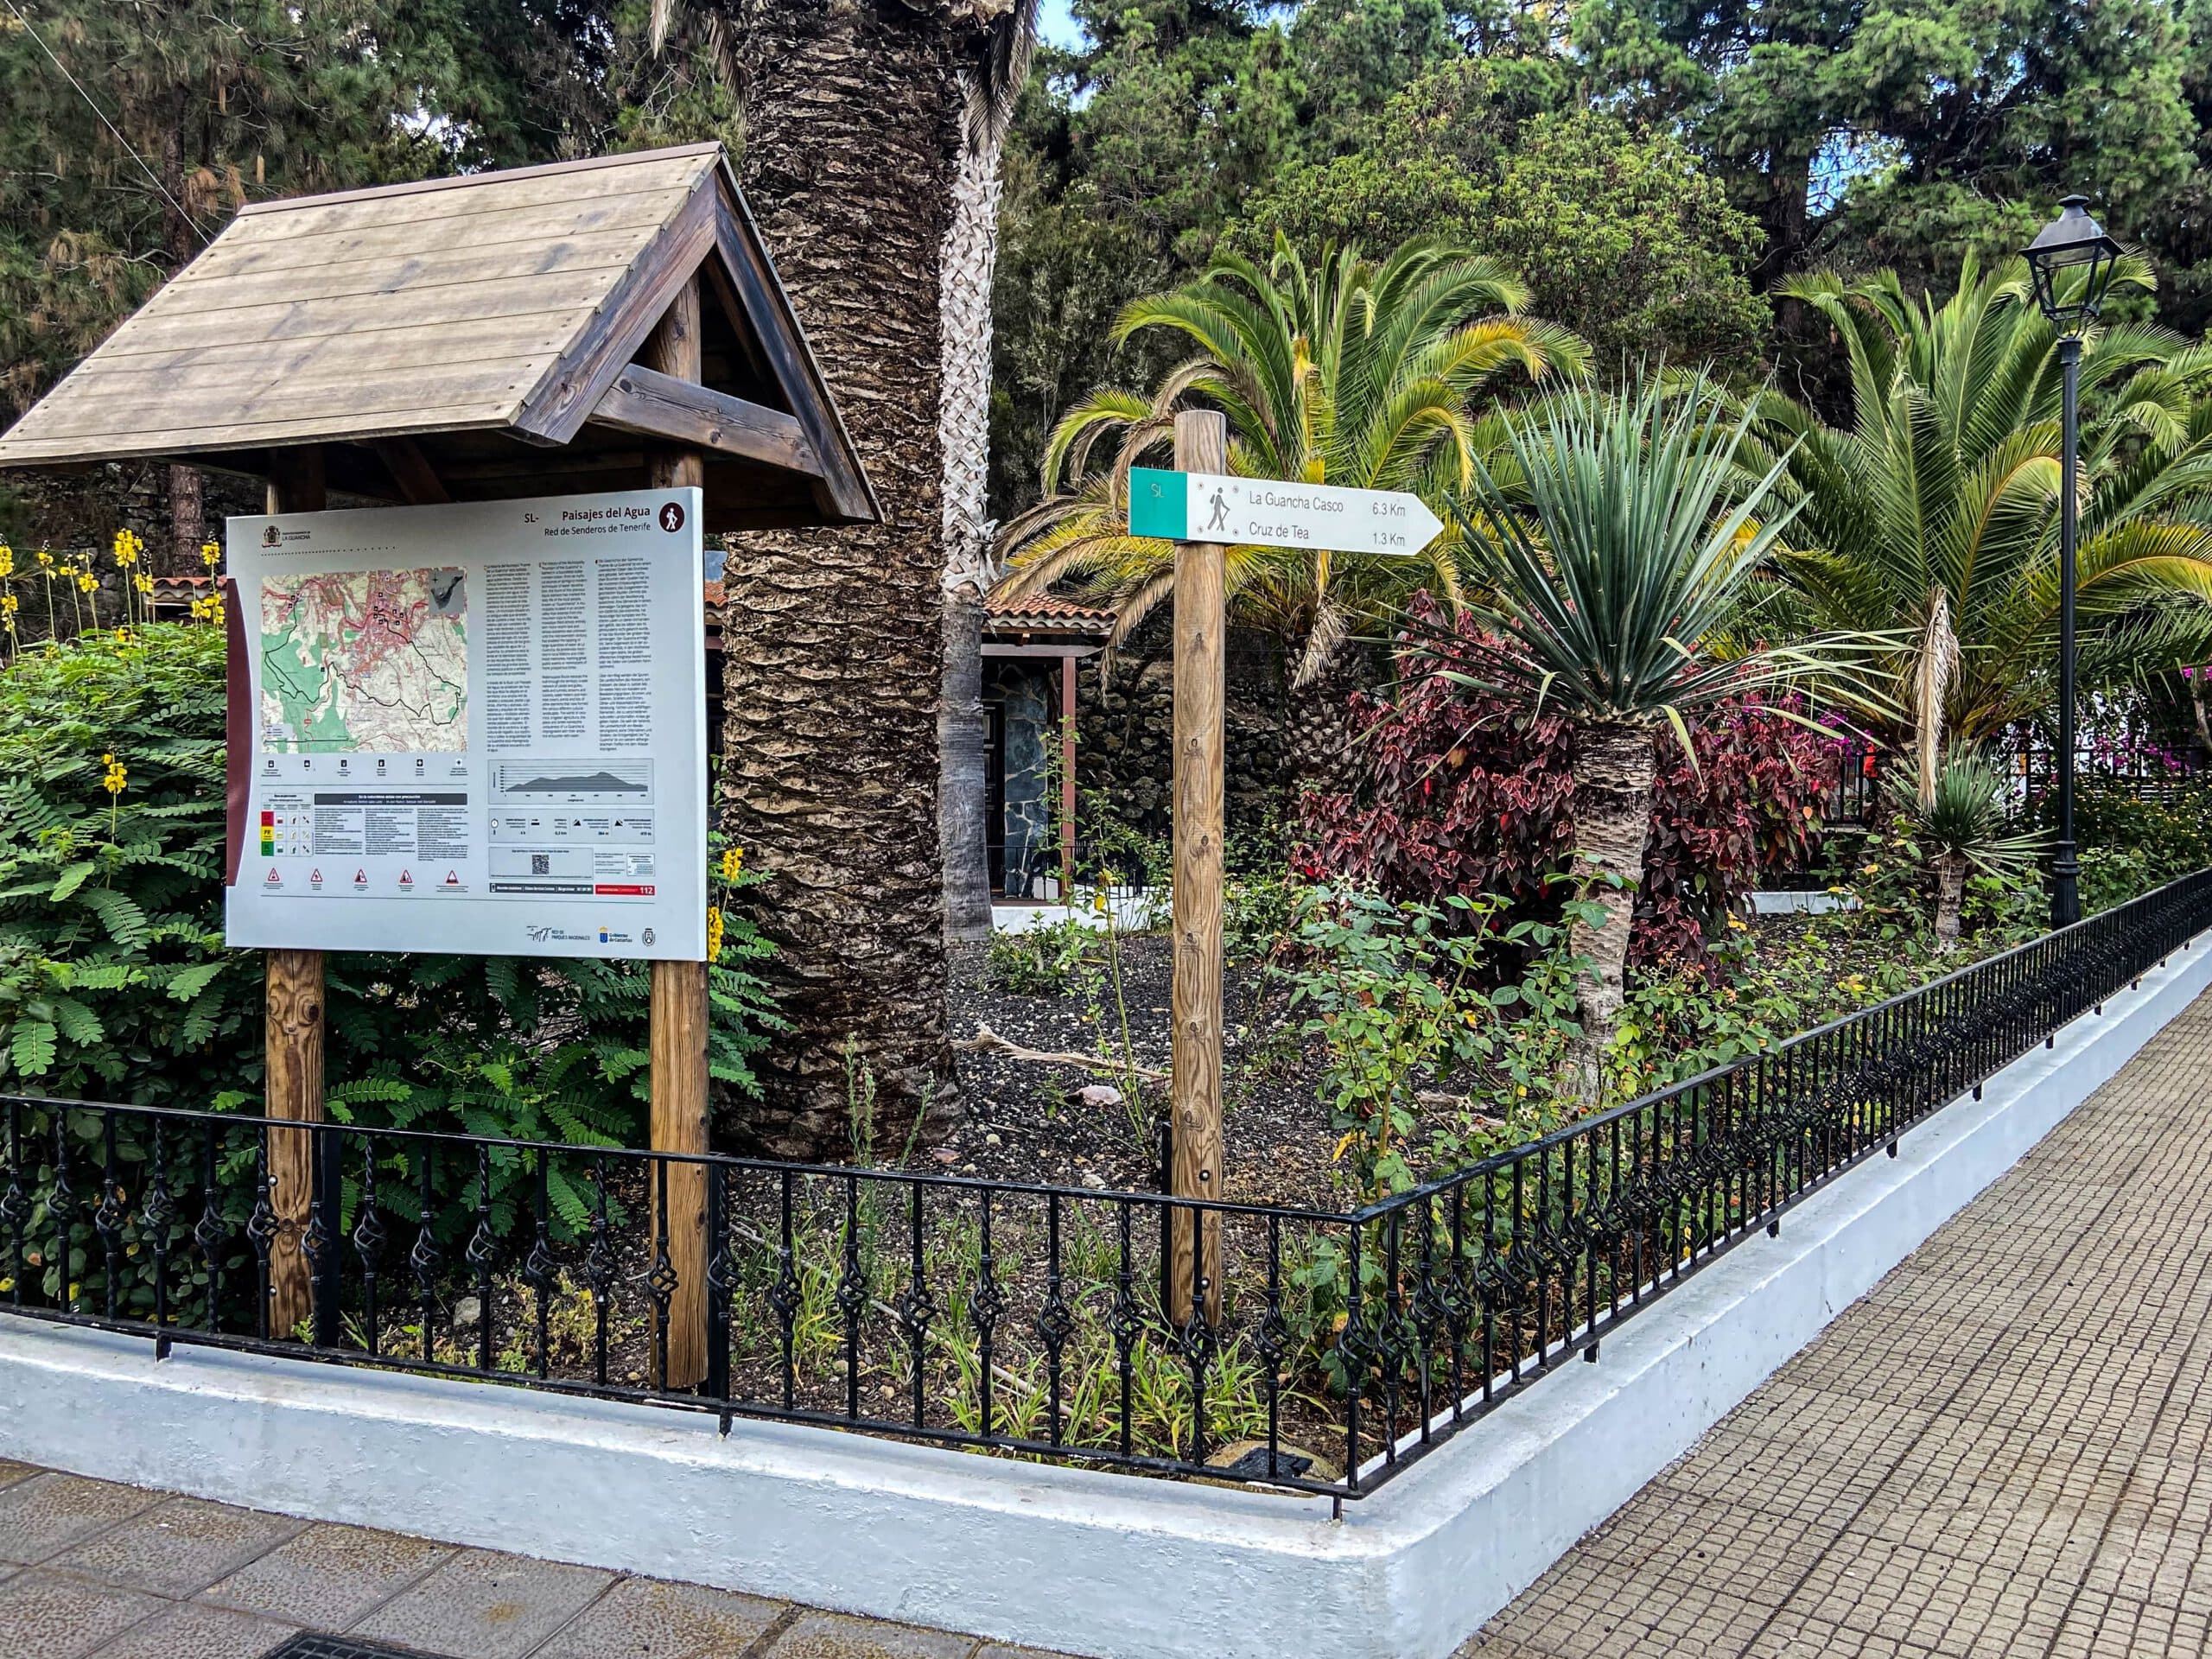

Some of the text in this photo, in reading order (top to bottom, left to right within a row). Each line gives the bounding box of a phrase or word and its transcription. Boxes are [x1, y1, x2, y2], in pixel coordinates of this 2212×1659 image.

[1150, 483, 1166, 499] SL
[1249, 491, 1344, 513] La Guancha Casco
[1372, 501, 1406, 517] 6.3 Km
[524, 506, 651, 523] SL- Paisajes del Agua
[544, 522, 651, 537] Red de Senderos de Tenerife
[1249, 522, 1309, 540] Cruz de Tea
[1373, 531, 1406, 547] 1.3 Km
